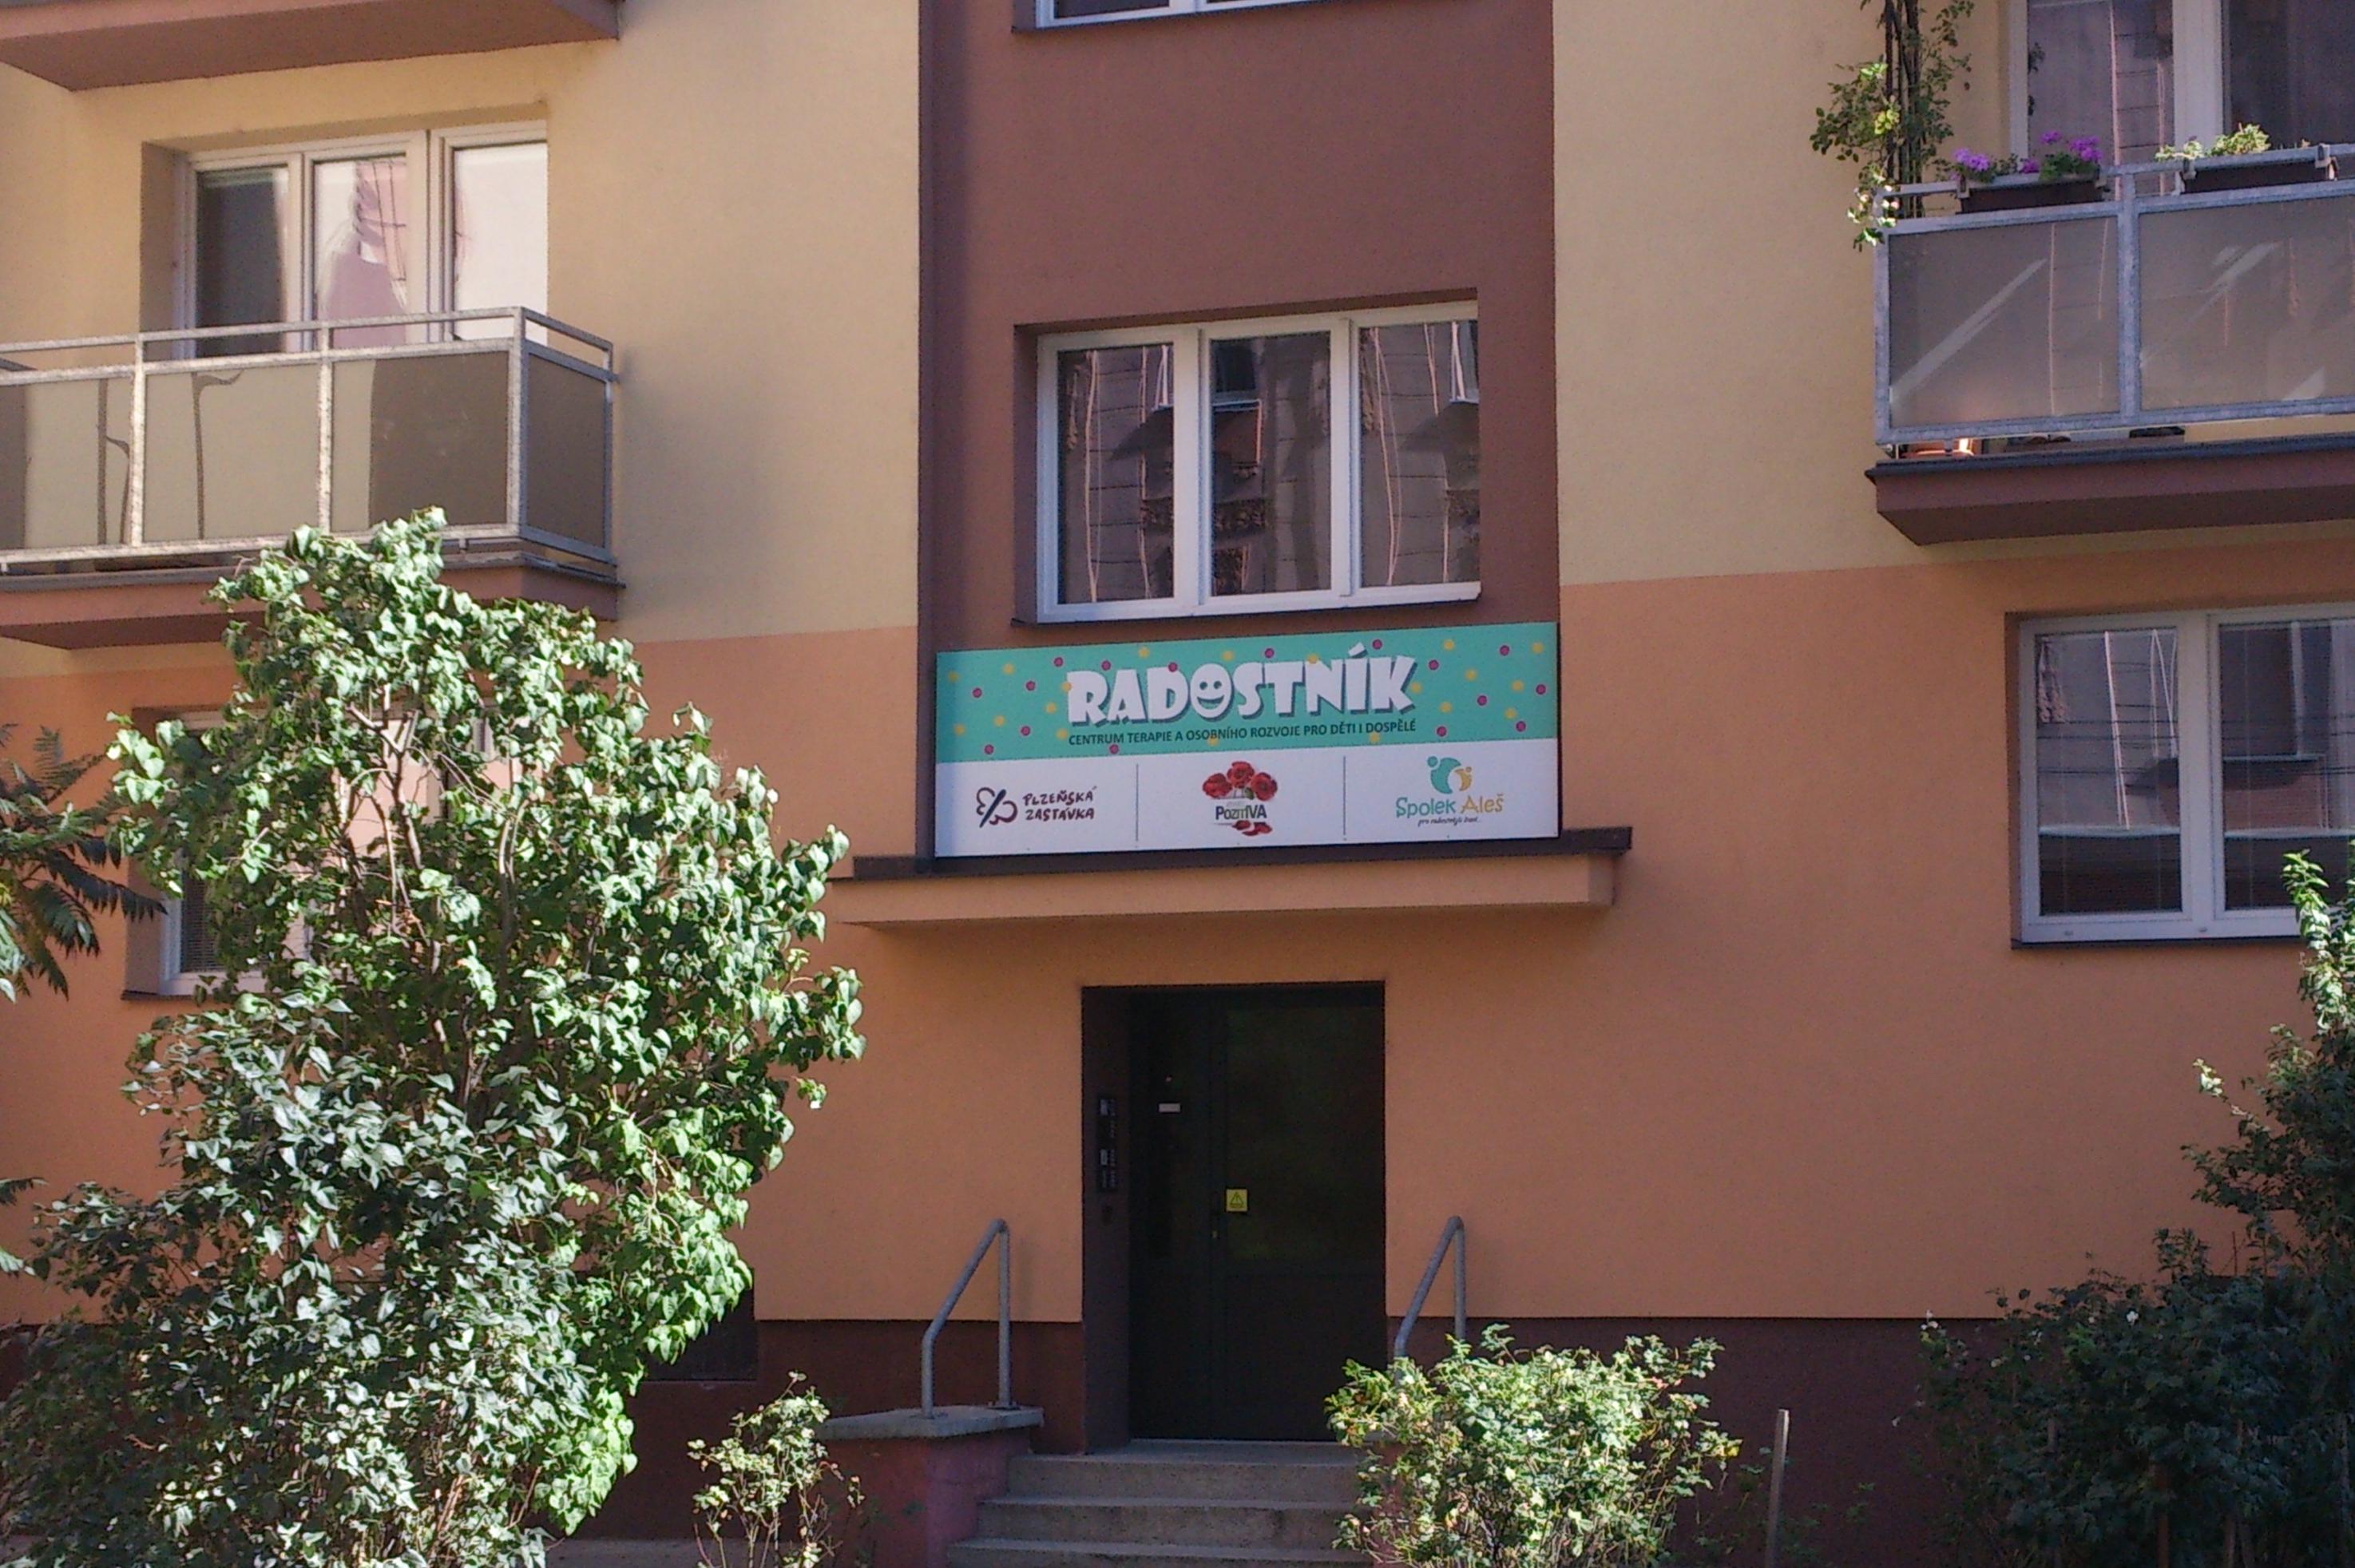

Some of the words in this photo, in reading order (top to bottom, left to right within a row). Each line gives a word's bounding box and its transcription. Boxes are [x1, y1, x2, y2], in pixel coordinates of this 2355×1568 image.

[1066, 642, 1417, 727] RADOSTNÍK
[1068, 733, 1124, 746] CENTRUM
[1127, 731, 1172, 743] TERAPIE
[1175, 730, 1183, 741] A
[1186, 725, 1247, 741] OSOBNÍHO
[1251, 725, 1300, 738] ROZVOJE
[1303, 724, 1327, 735] PRO
[1330, 721, 1356, 735] DĚTI
[1358, 723, 1362, 733] I
[1366, 718, 1417, 732] DOSPĚLÉ
[1022, 786, 1097, 806] PLZEŇSKÁ
[1396, 797, 1457, 818] Spolek
[1461, 793, 1505, 814] Aleš
[1025, 806, 1095, 822] ZASTÁVKA
